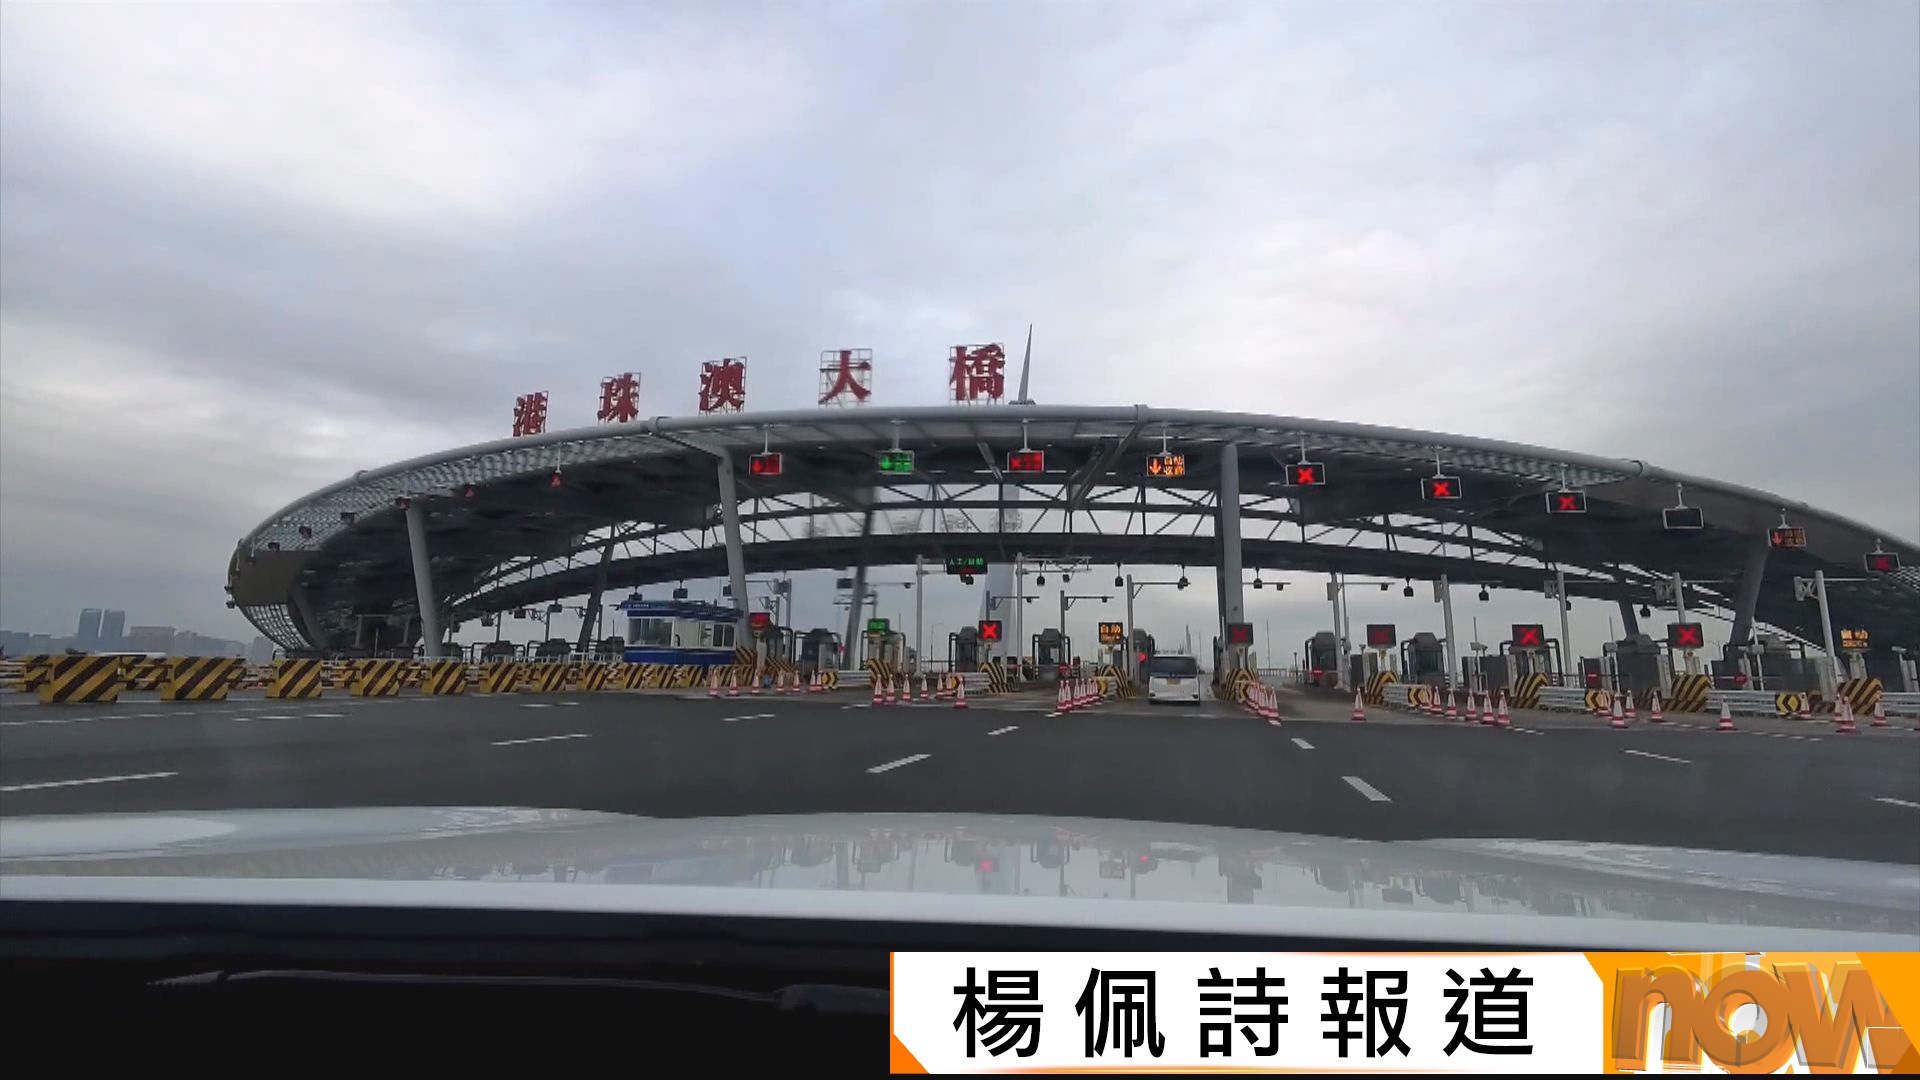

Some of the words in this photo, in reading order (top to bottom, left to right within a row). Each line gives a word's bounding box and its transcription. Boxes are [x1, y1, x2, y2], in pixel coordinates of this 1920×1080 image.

[513, 343, 1005, 436] 港珠澳大橋
